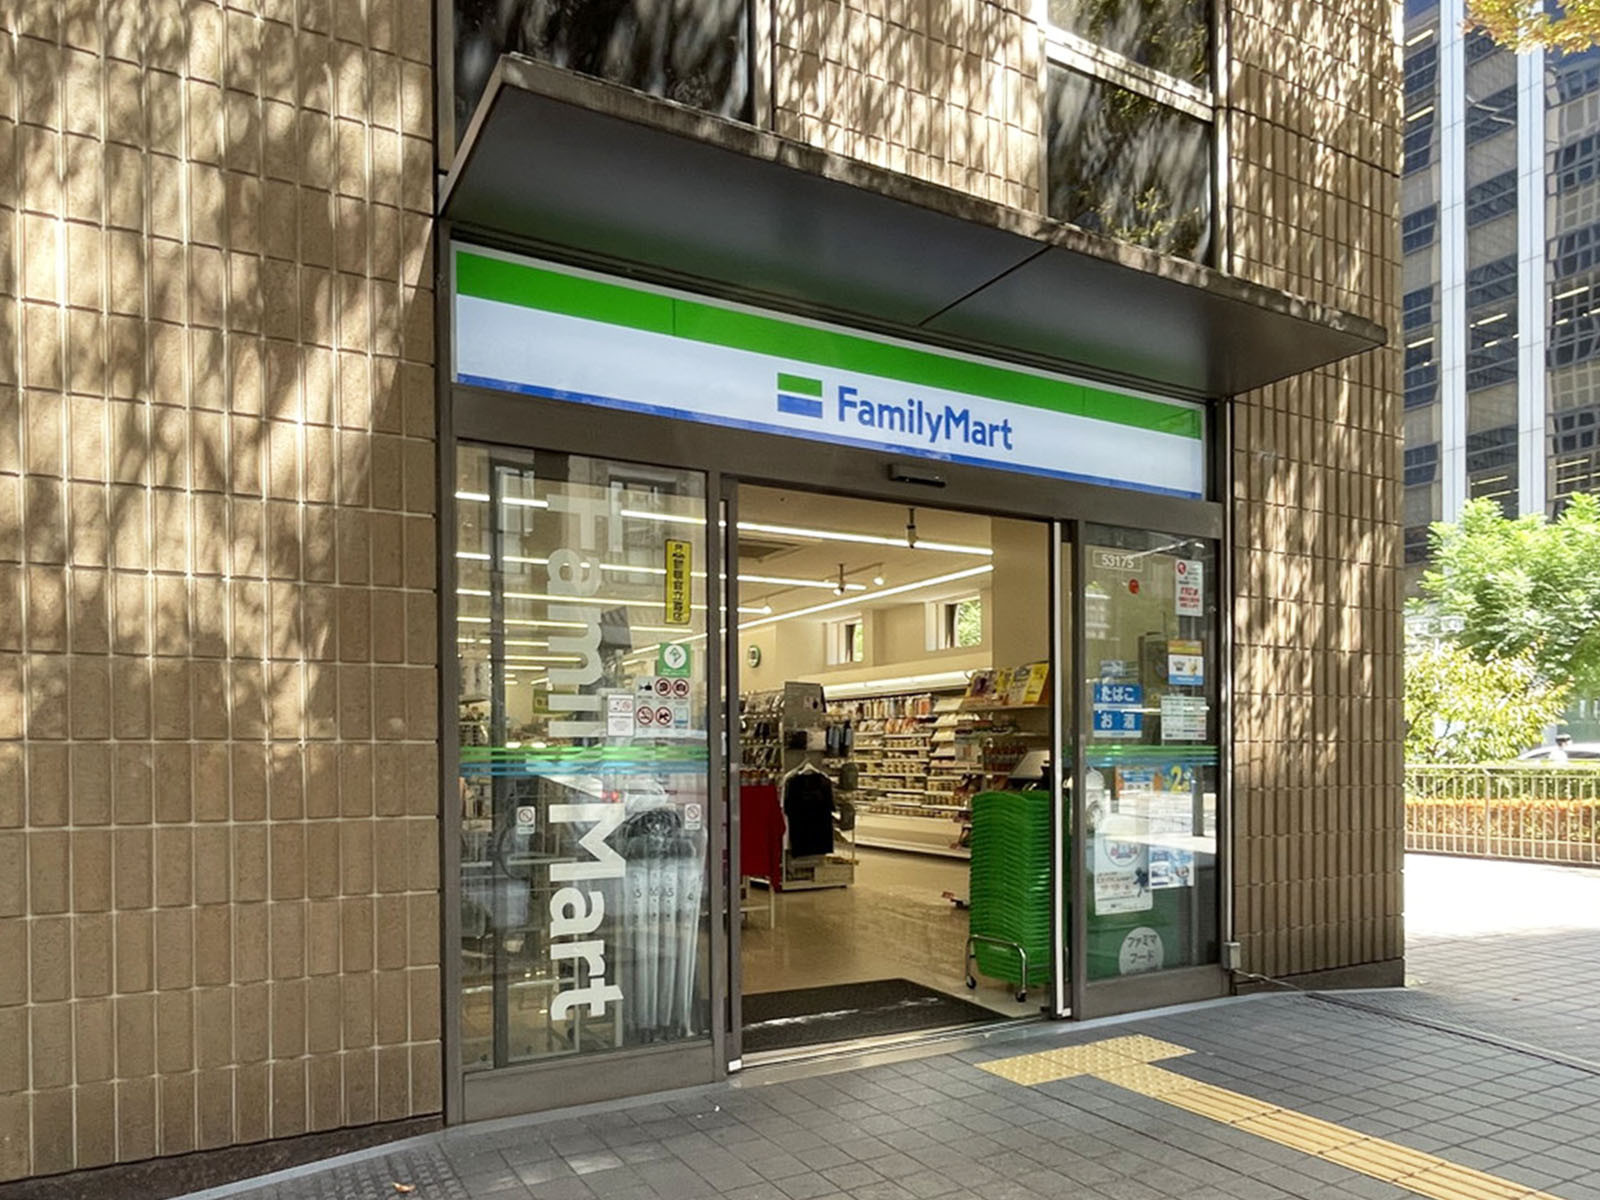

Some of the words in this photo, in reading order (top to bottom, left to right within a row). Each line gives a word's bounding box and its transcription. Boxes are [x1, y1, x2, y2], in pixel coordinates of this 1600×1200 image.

[838, 385, 1013, 450] FamilyMart
[1102, 553, 1135, 569] 53175
[1101, 685, 1135, 702] たばこ
[1101, 712, 1136, 729] お酒
[1127, 934, 1158, 948] ファミマ
[1129, 949, 1155, 965] フード
